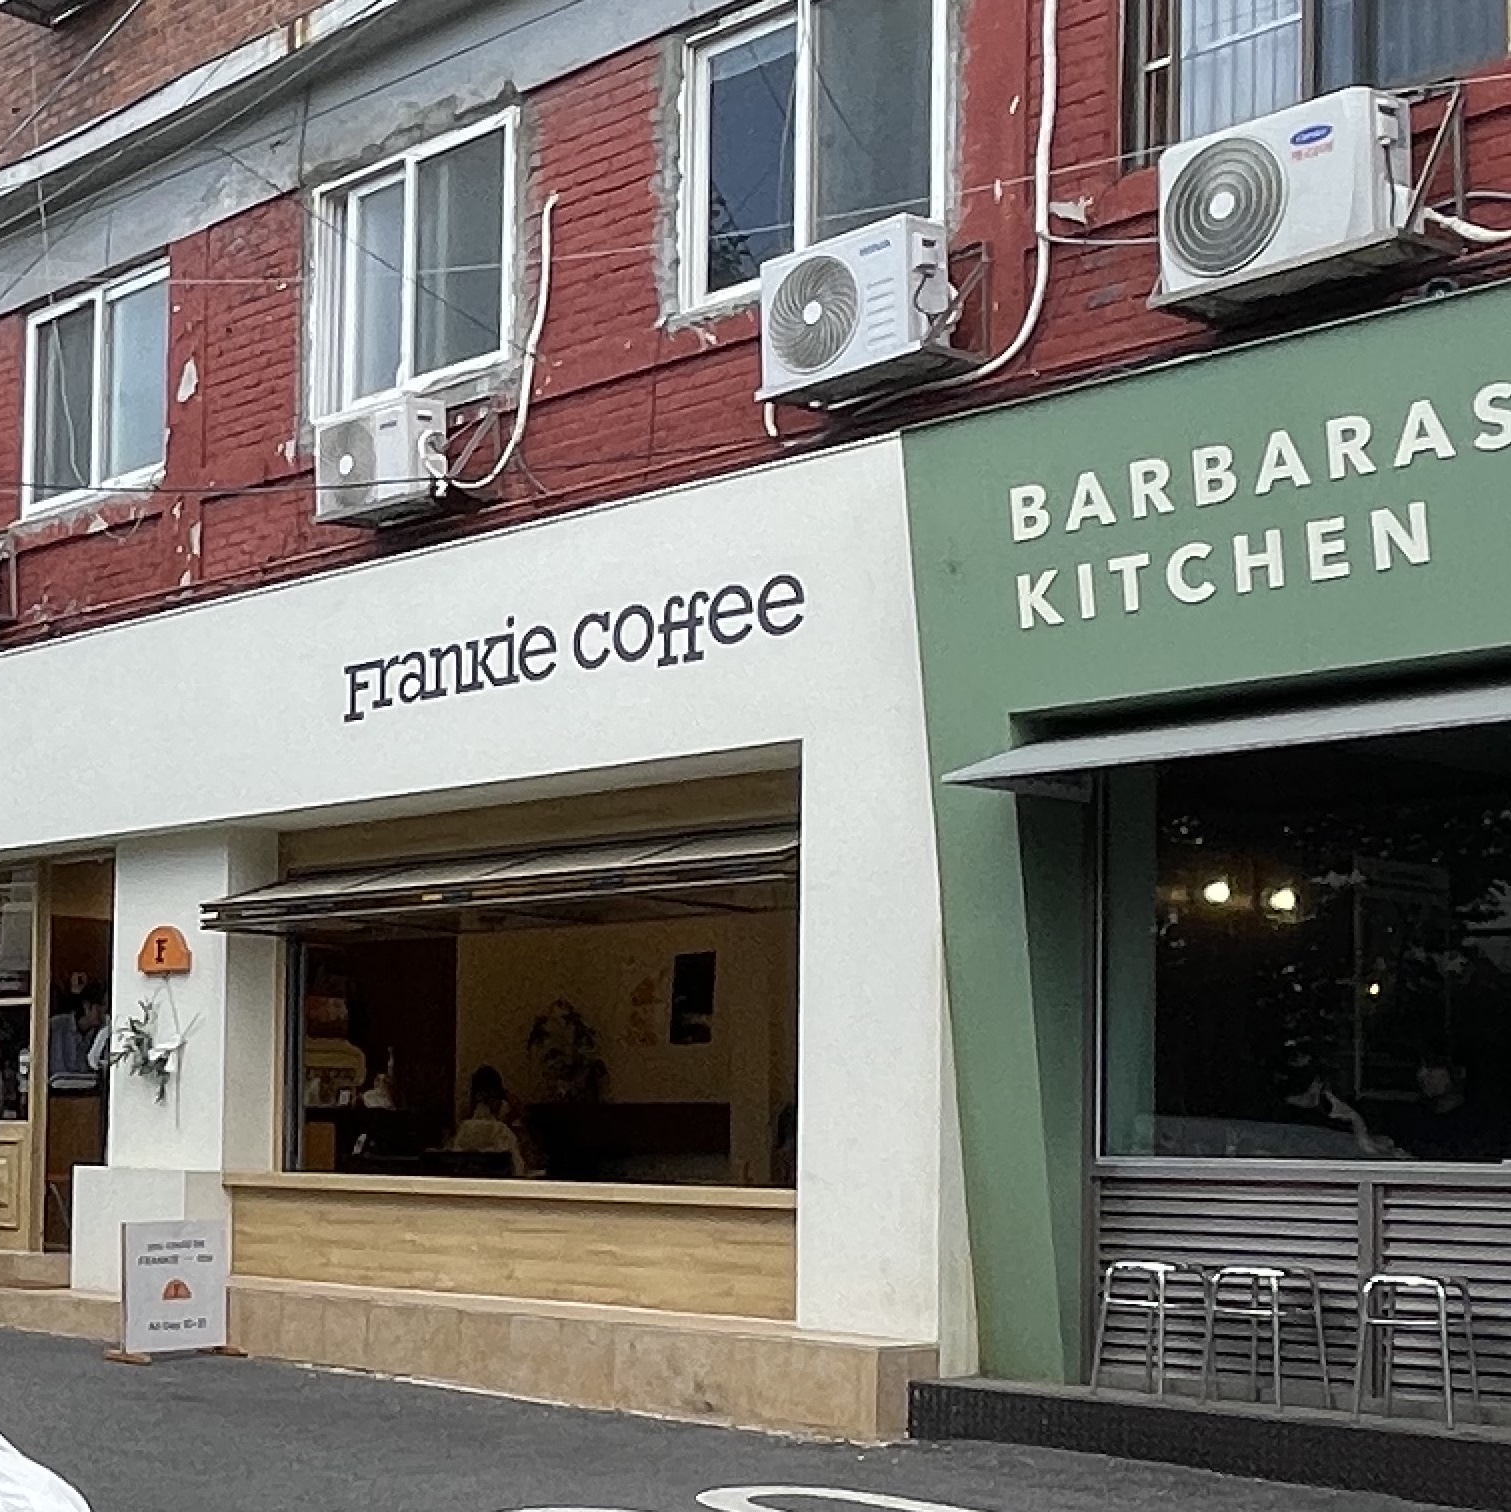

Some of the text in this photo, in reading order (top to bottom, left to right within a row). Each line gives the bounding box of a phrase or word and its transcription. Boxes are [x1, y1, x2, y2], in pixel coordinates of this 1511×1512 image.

[1009, 381, 1510, 542] BARBARAS
[1016, 501, 1431, 629] KITCHEN
[343, 616, 557, 723] Frankie
[154, 937, 169, 964] F
